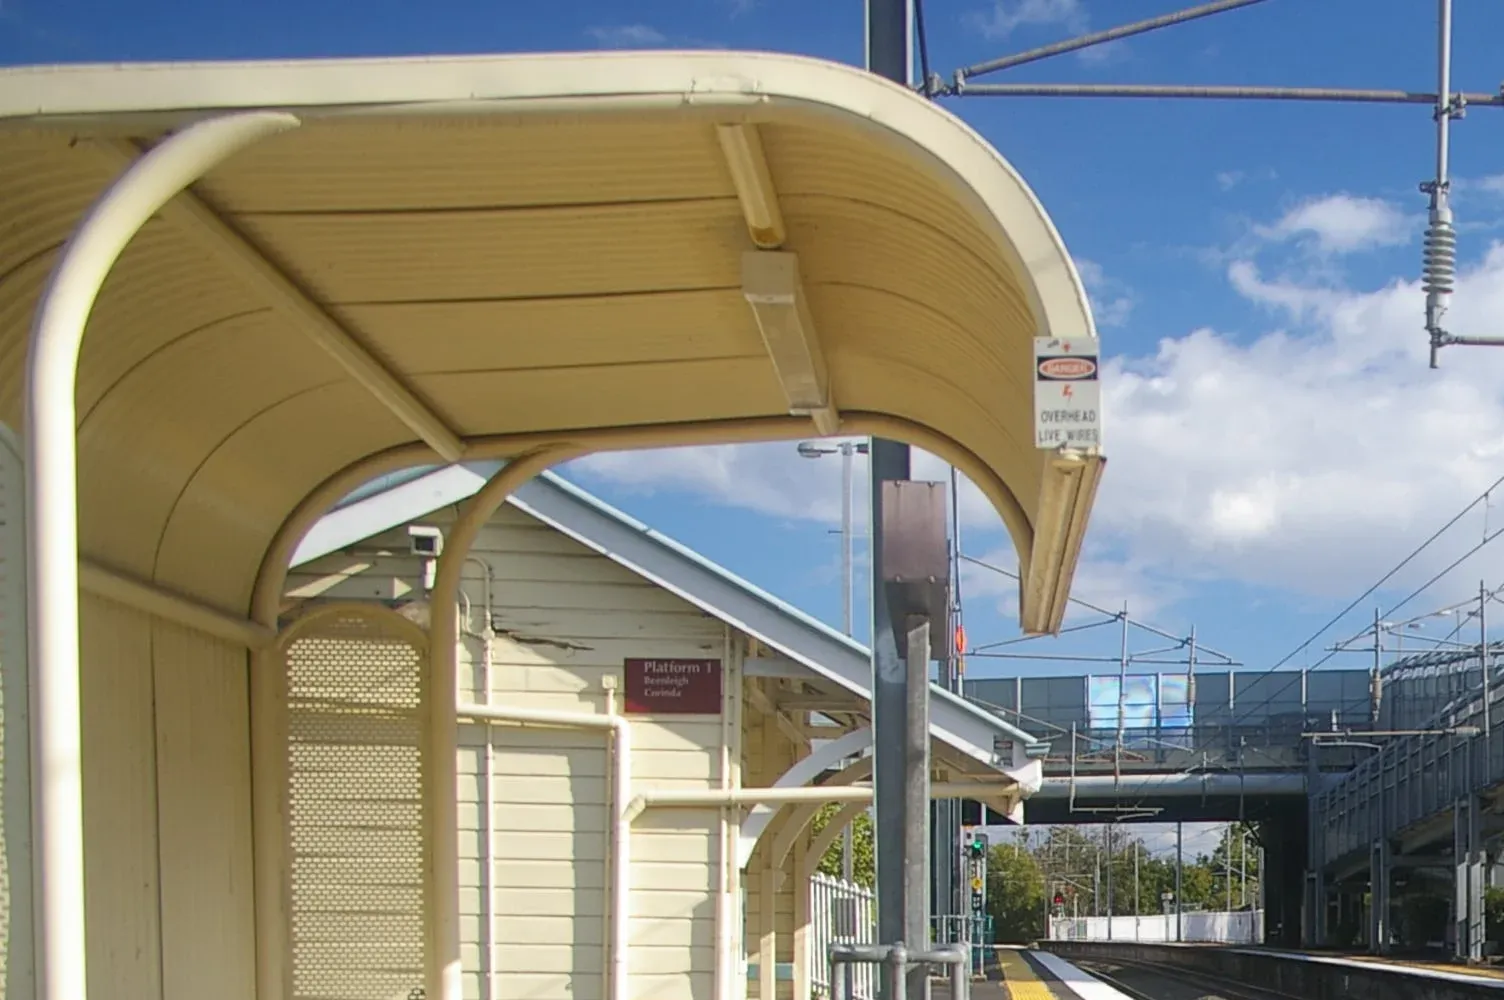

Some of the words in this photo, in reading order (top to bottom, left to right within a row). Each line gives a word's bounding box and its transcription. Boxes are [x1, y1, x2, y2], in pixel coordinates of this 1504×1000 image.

[1041, 410, 1096, 423] OVERHEAD
[1039, 428, 1060, 441] LIVE
[1066, 428, 1098, 442] WIRES
[644, 661, 700, 673] Platform
[705, 662, 712, 673] 1
